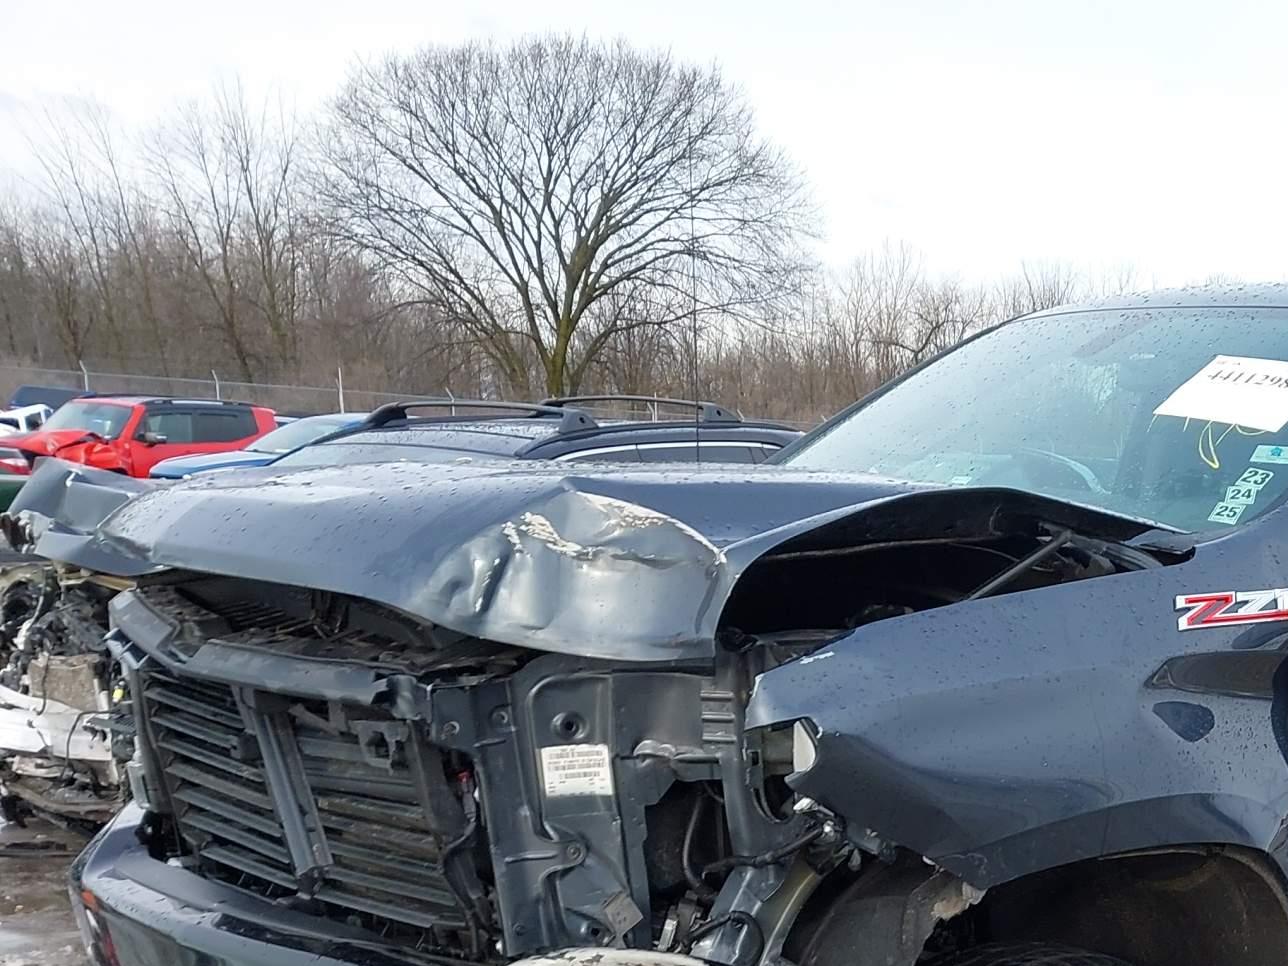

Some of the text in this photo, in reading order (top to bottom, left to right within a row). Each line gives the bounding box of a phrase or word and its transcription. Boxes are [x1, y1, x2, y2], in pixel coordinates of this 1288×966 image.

[1240, 469, 1270, 486] 23
[1229, 488, 1253, 500] 24
[1215, 505, 1241, 518] 25
